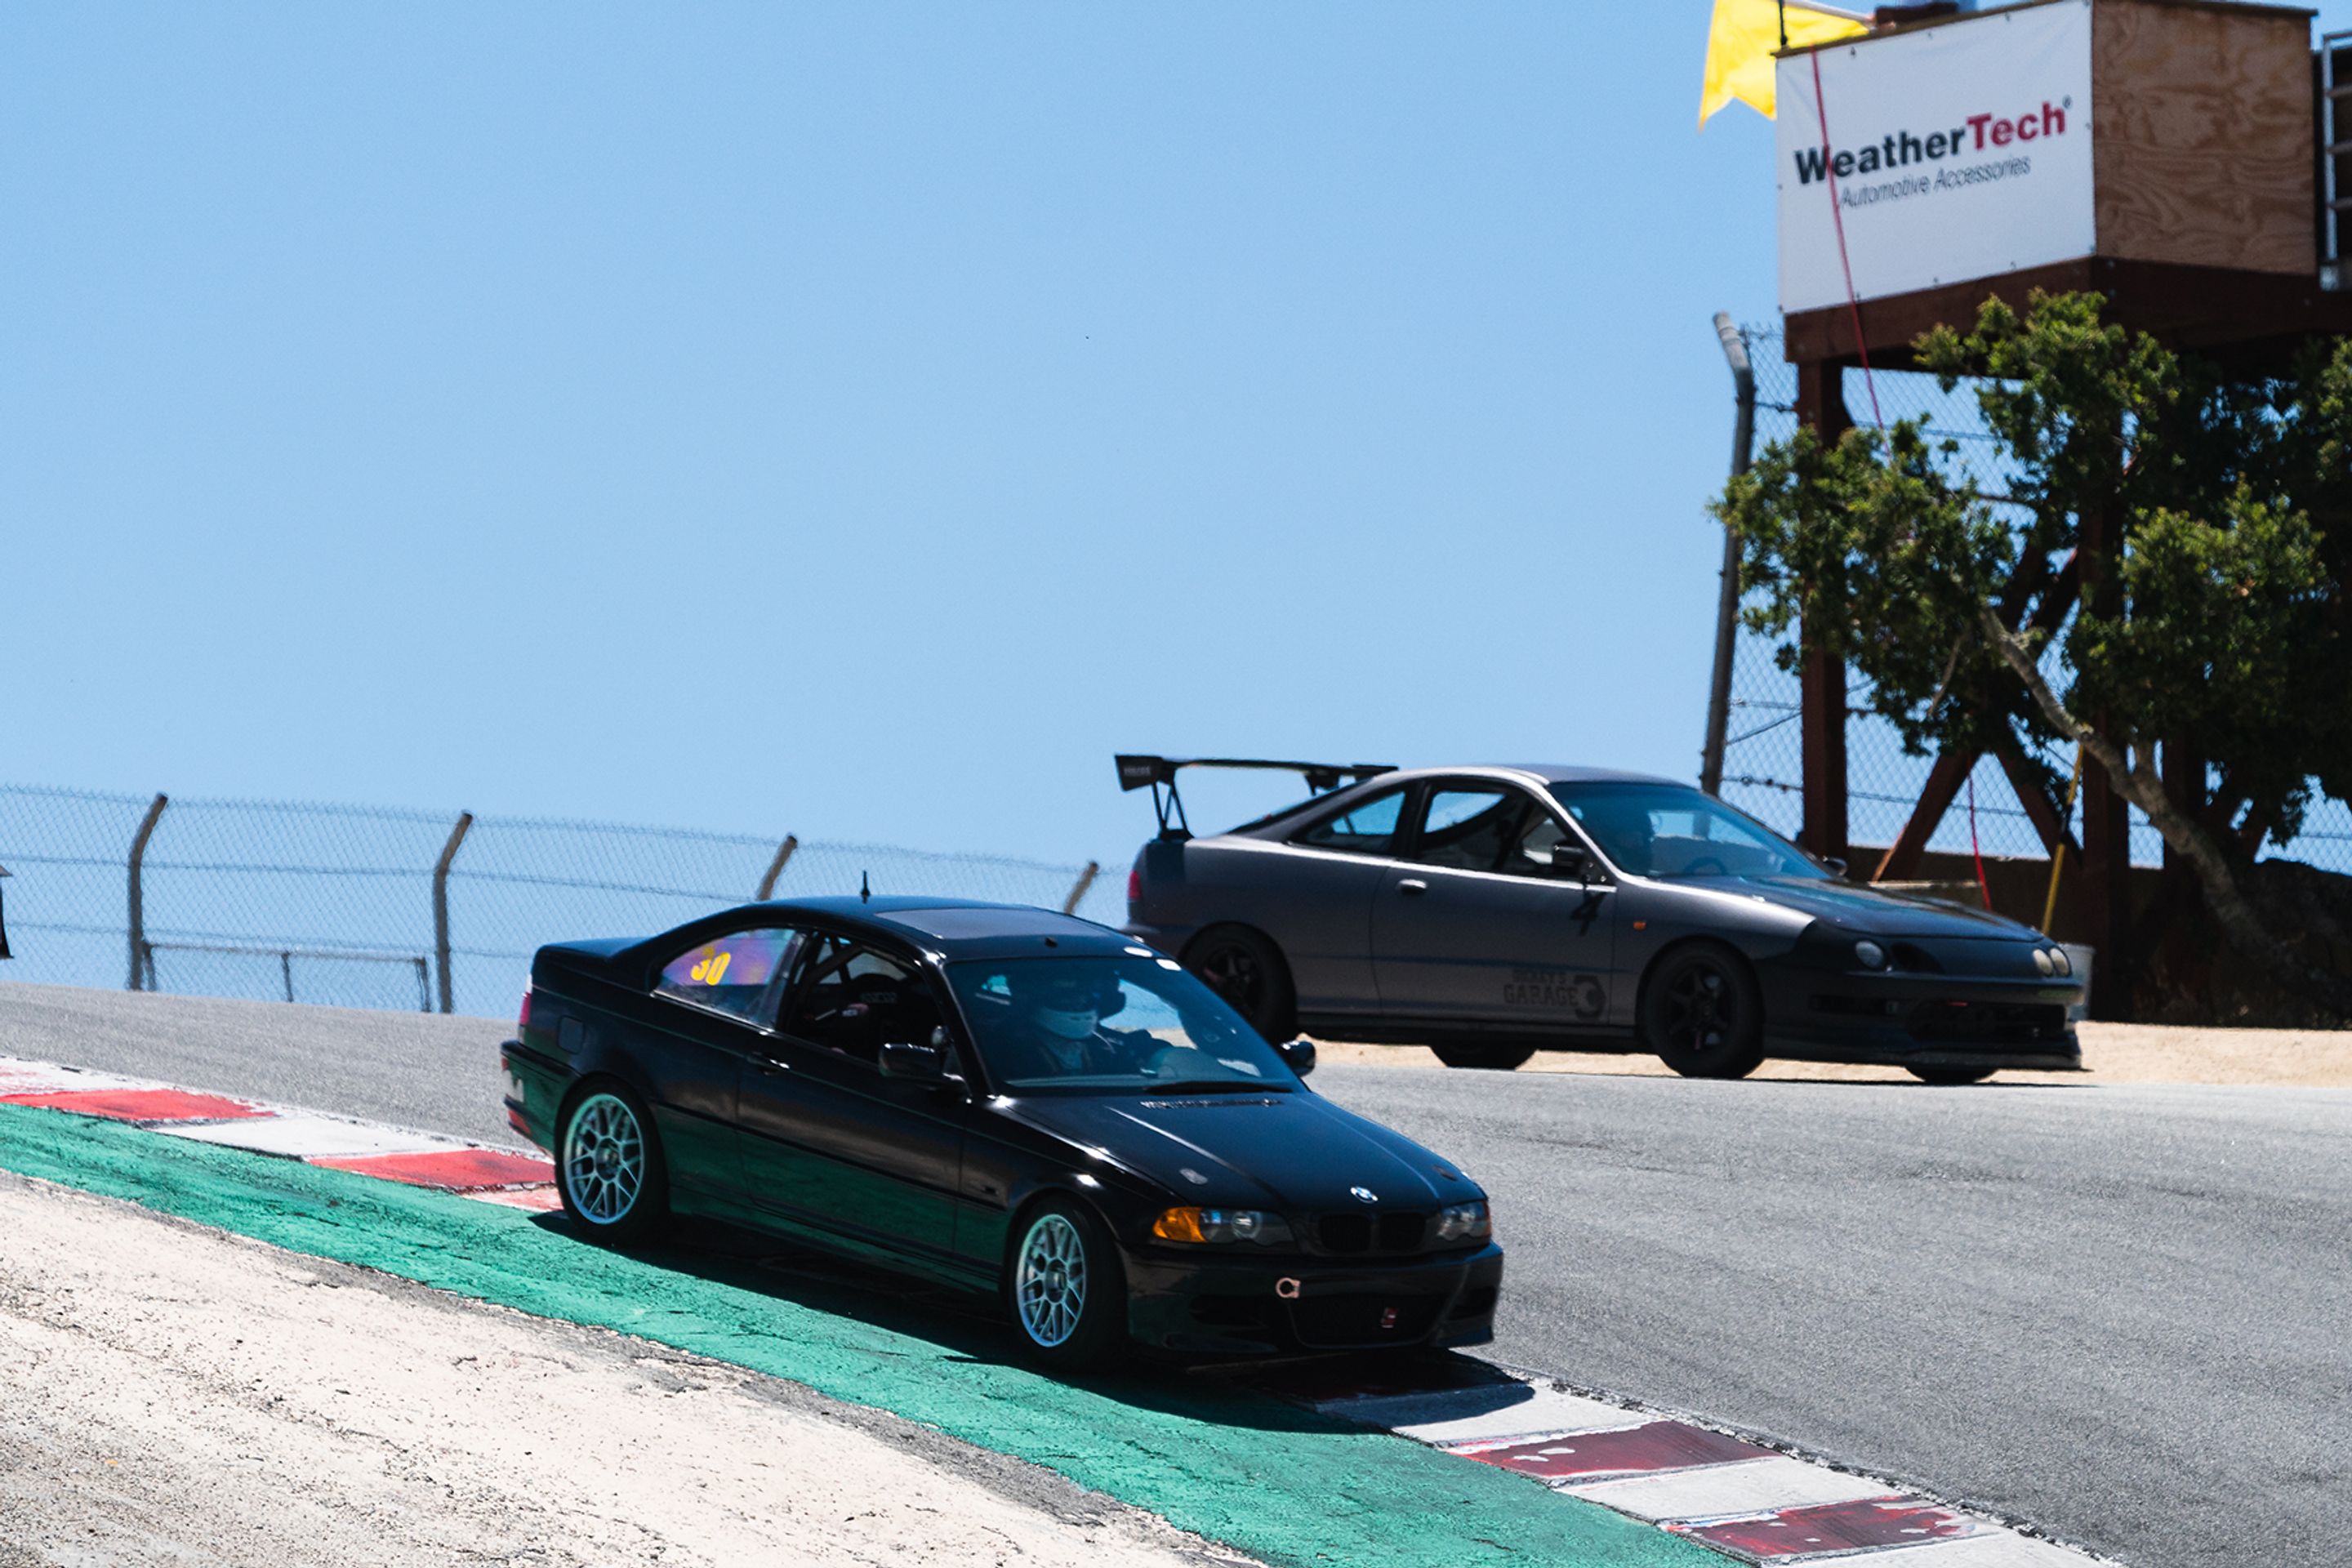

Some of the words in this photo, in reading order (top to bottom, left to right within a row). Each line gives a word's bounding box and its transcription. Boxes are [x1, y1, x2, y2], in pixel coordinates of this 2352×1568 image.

[1793, 100, 2066, 185] WeatherTech
[1841, 173, 1931, 210] Automotive
[1933, 155, 2031, 193] Accessories
[691, 947, 731, 987] 30
[1503, 983, 1579, 1006] GARAGE
